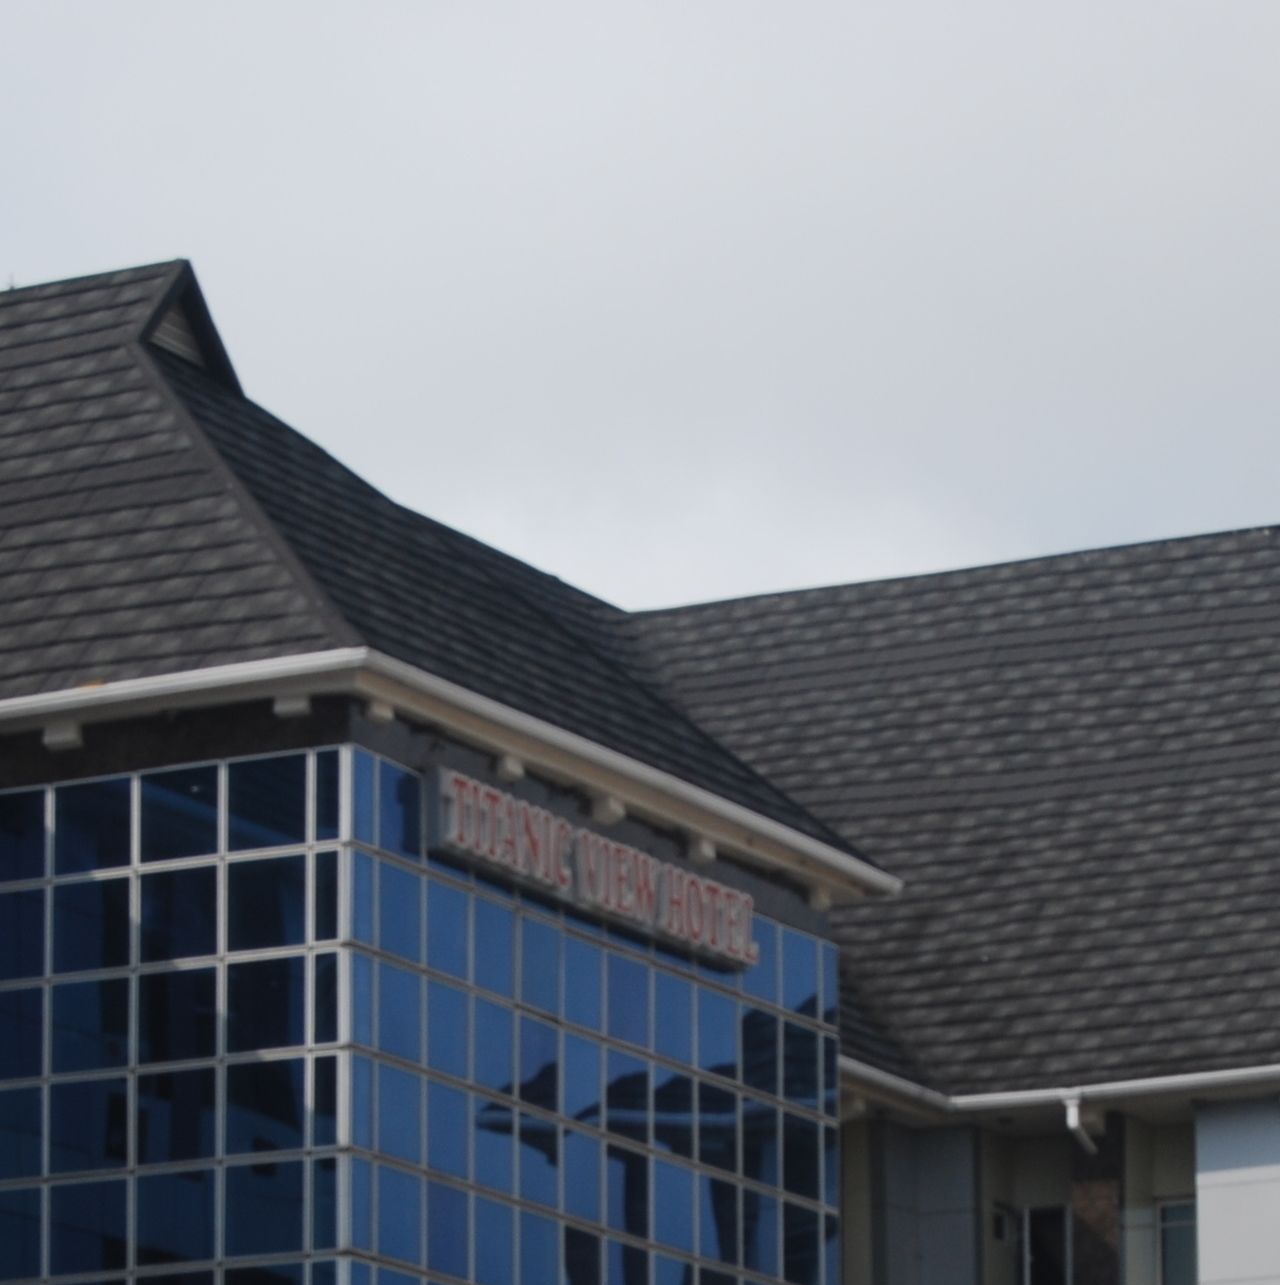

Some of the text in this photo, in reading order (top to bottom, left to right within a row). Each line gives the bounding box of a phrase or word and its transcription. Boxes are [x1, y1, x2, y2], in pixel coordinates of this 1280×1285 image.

[451, 776, 759, 963] TITANIC VIEW HOTEL
